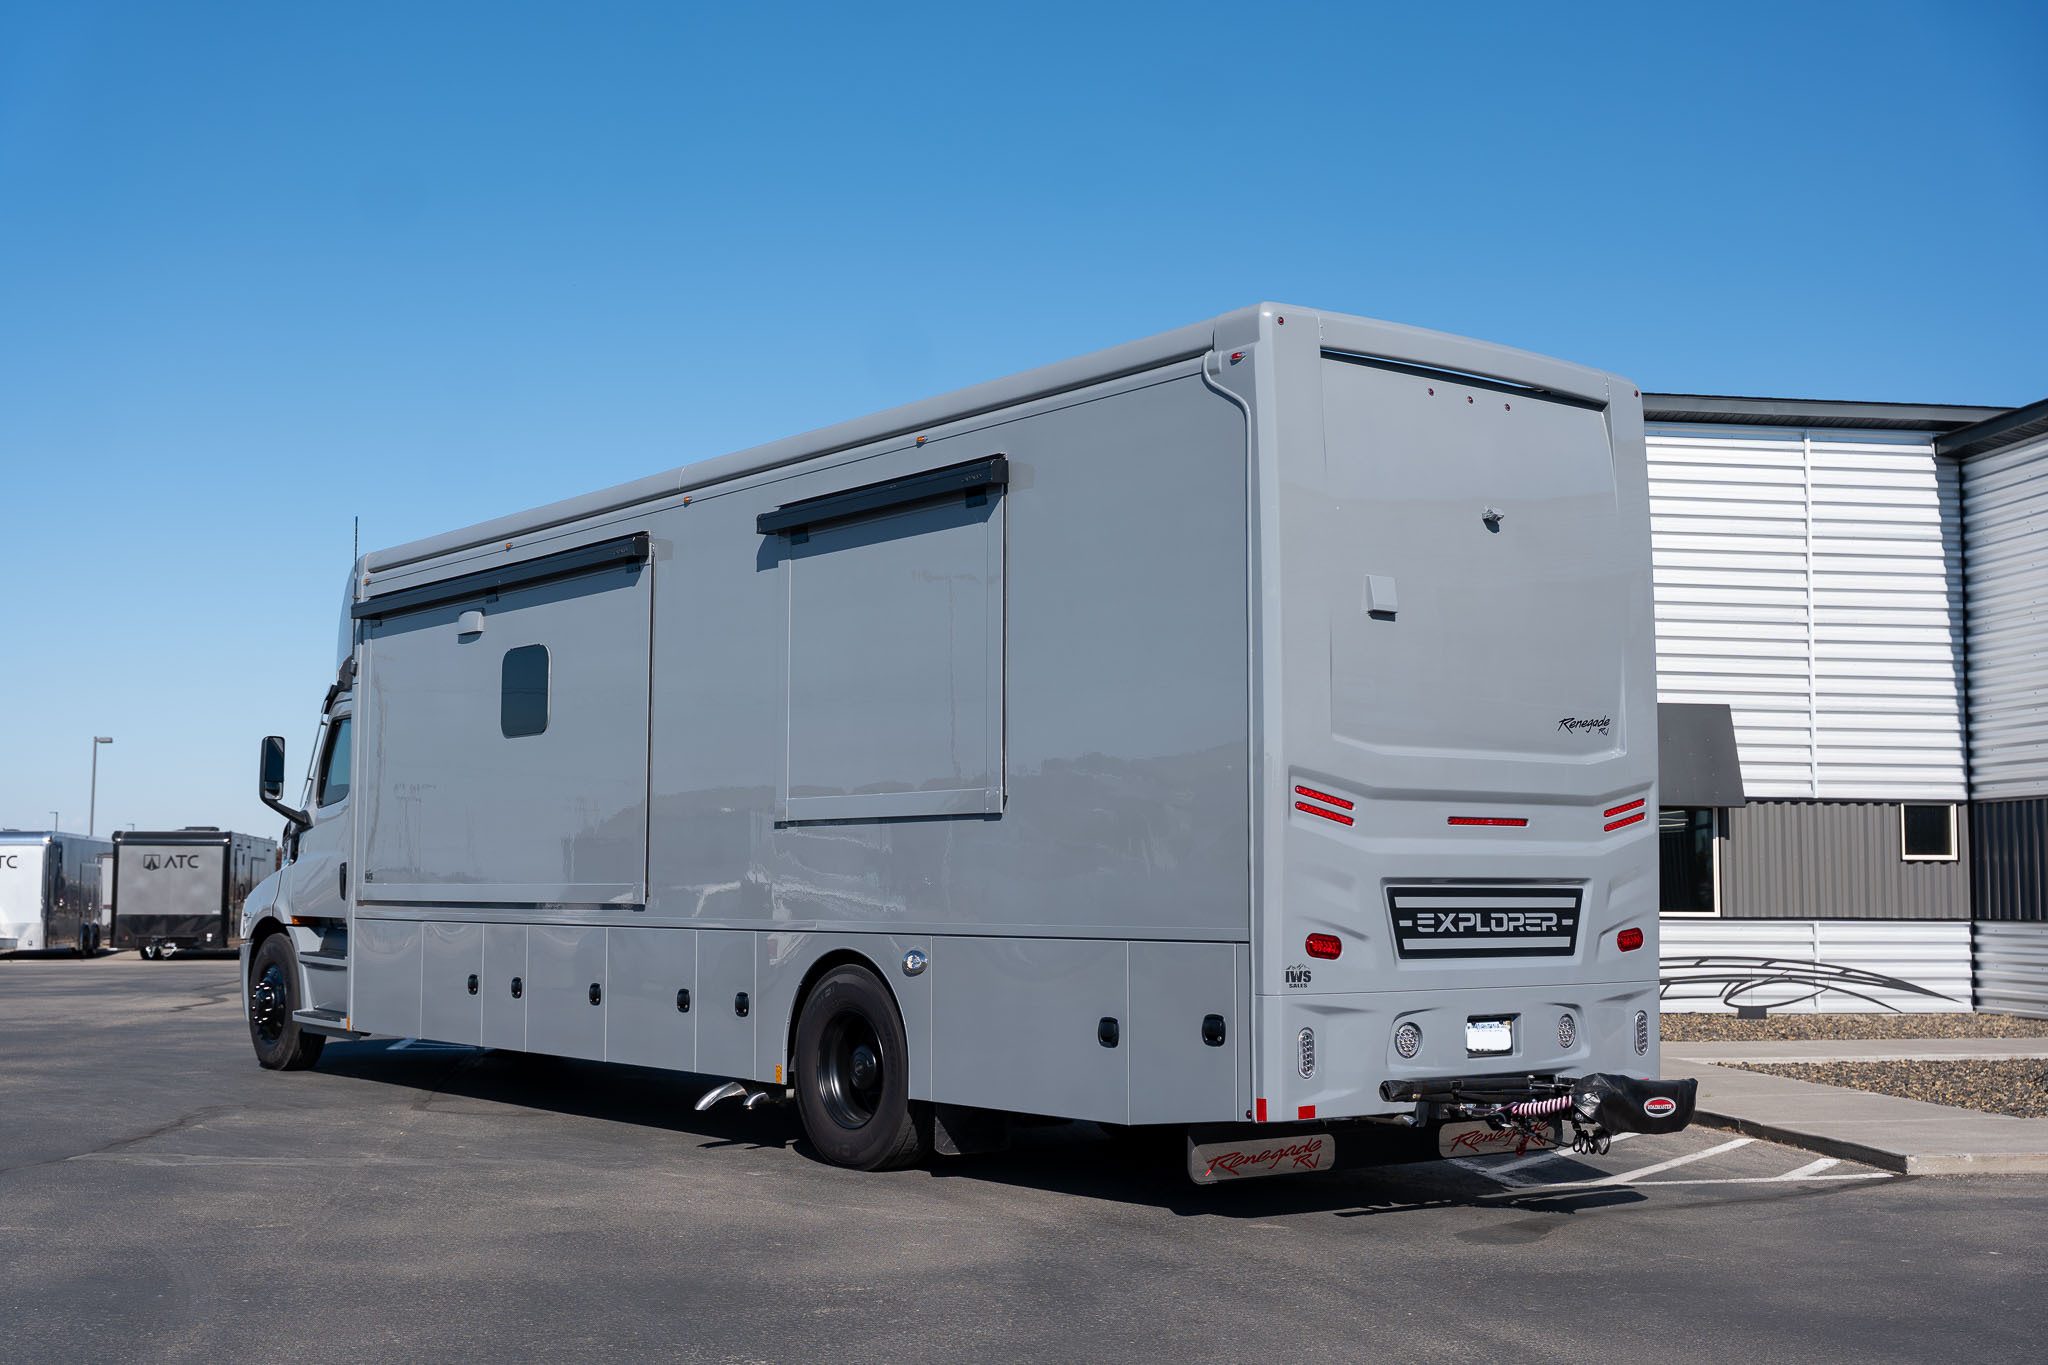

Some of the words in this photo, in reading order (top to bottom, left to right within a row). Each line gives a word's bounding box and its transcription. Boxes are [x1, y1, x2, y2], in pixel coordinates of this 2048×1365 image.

[1558, 714, 1610, 734] Renegade
[1598, 727, 1609, 736] RV
[164, 854, 199, 869] ATC
[1416, 912, 1558, 933] EXPLORER
[1285, 970, 1312, 983] IWS
[1204, 1137, 1323, 1177] Renegade
[1292, 1153, 1321, 1169] RV
